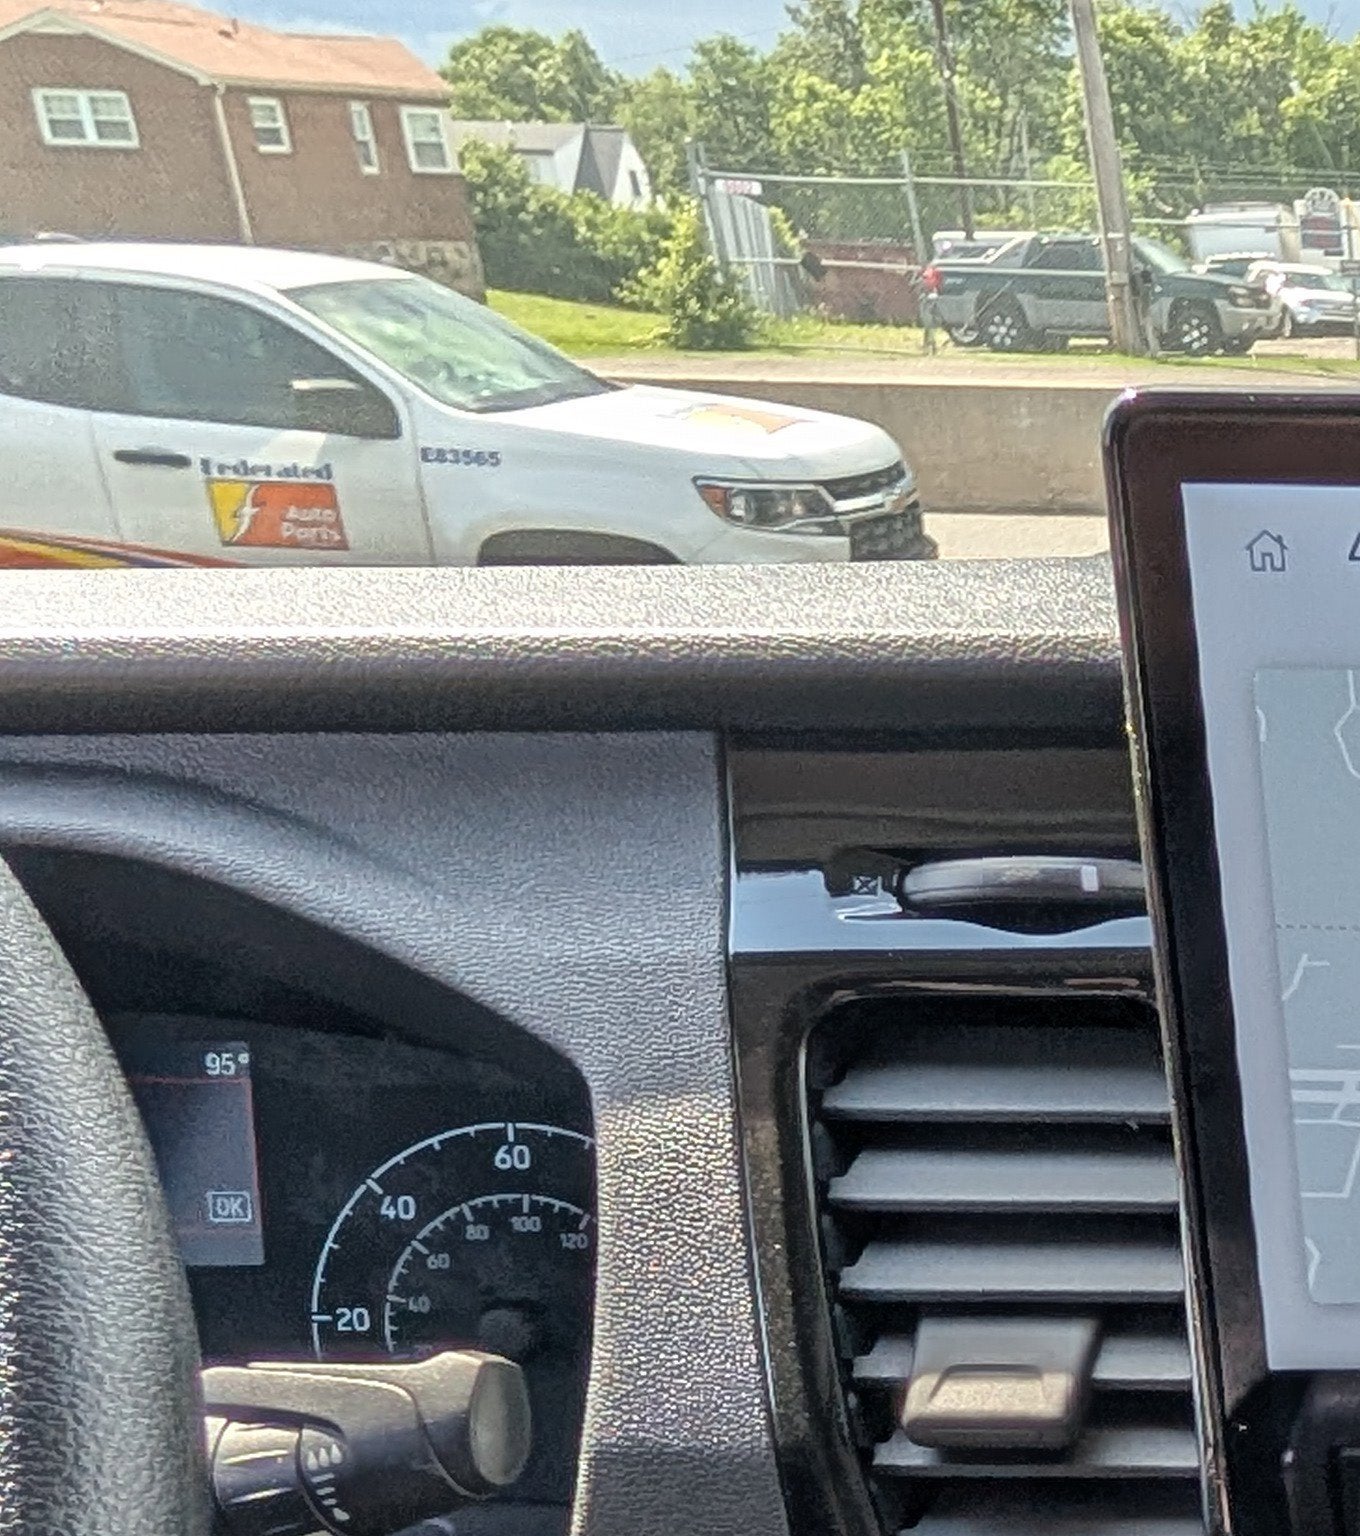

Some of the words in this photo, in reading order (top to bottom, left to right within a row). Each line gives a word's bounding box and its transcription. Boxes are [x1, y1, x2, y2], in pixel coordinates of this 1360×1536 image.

[285, 506, 338, 522] Auto
[493, 1144, 532, 1171] 60
[216, 1196, 245, 1218] OK
[380, 1195, 417, 1221] 40
[465, 1224, 490, 1243] 80
[510, 1216, 542, 1235] 100
[560, 1232, 588, 1251] 120
[426, 1253, 451, 1271] 60
[335, 1307, 370, 1333] 20
